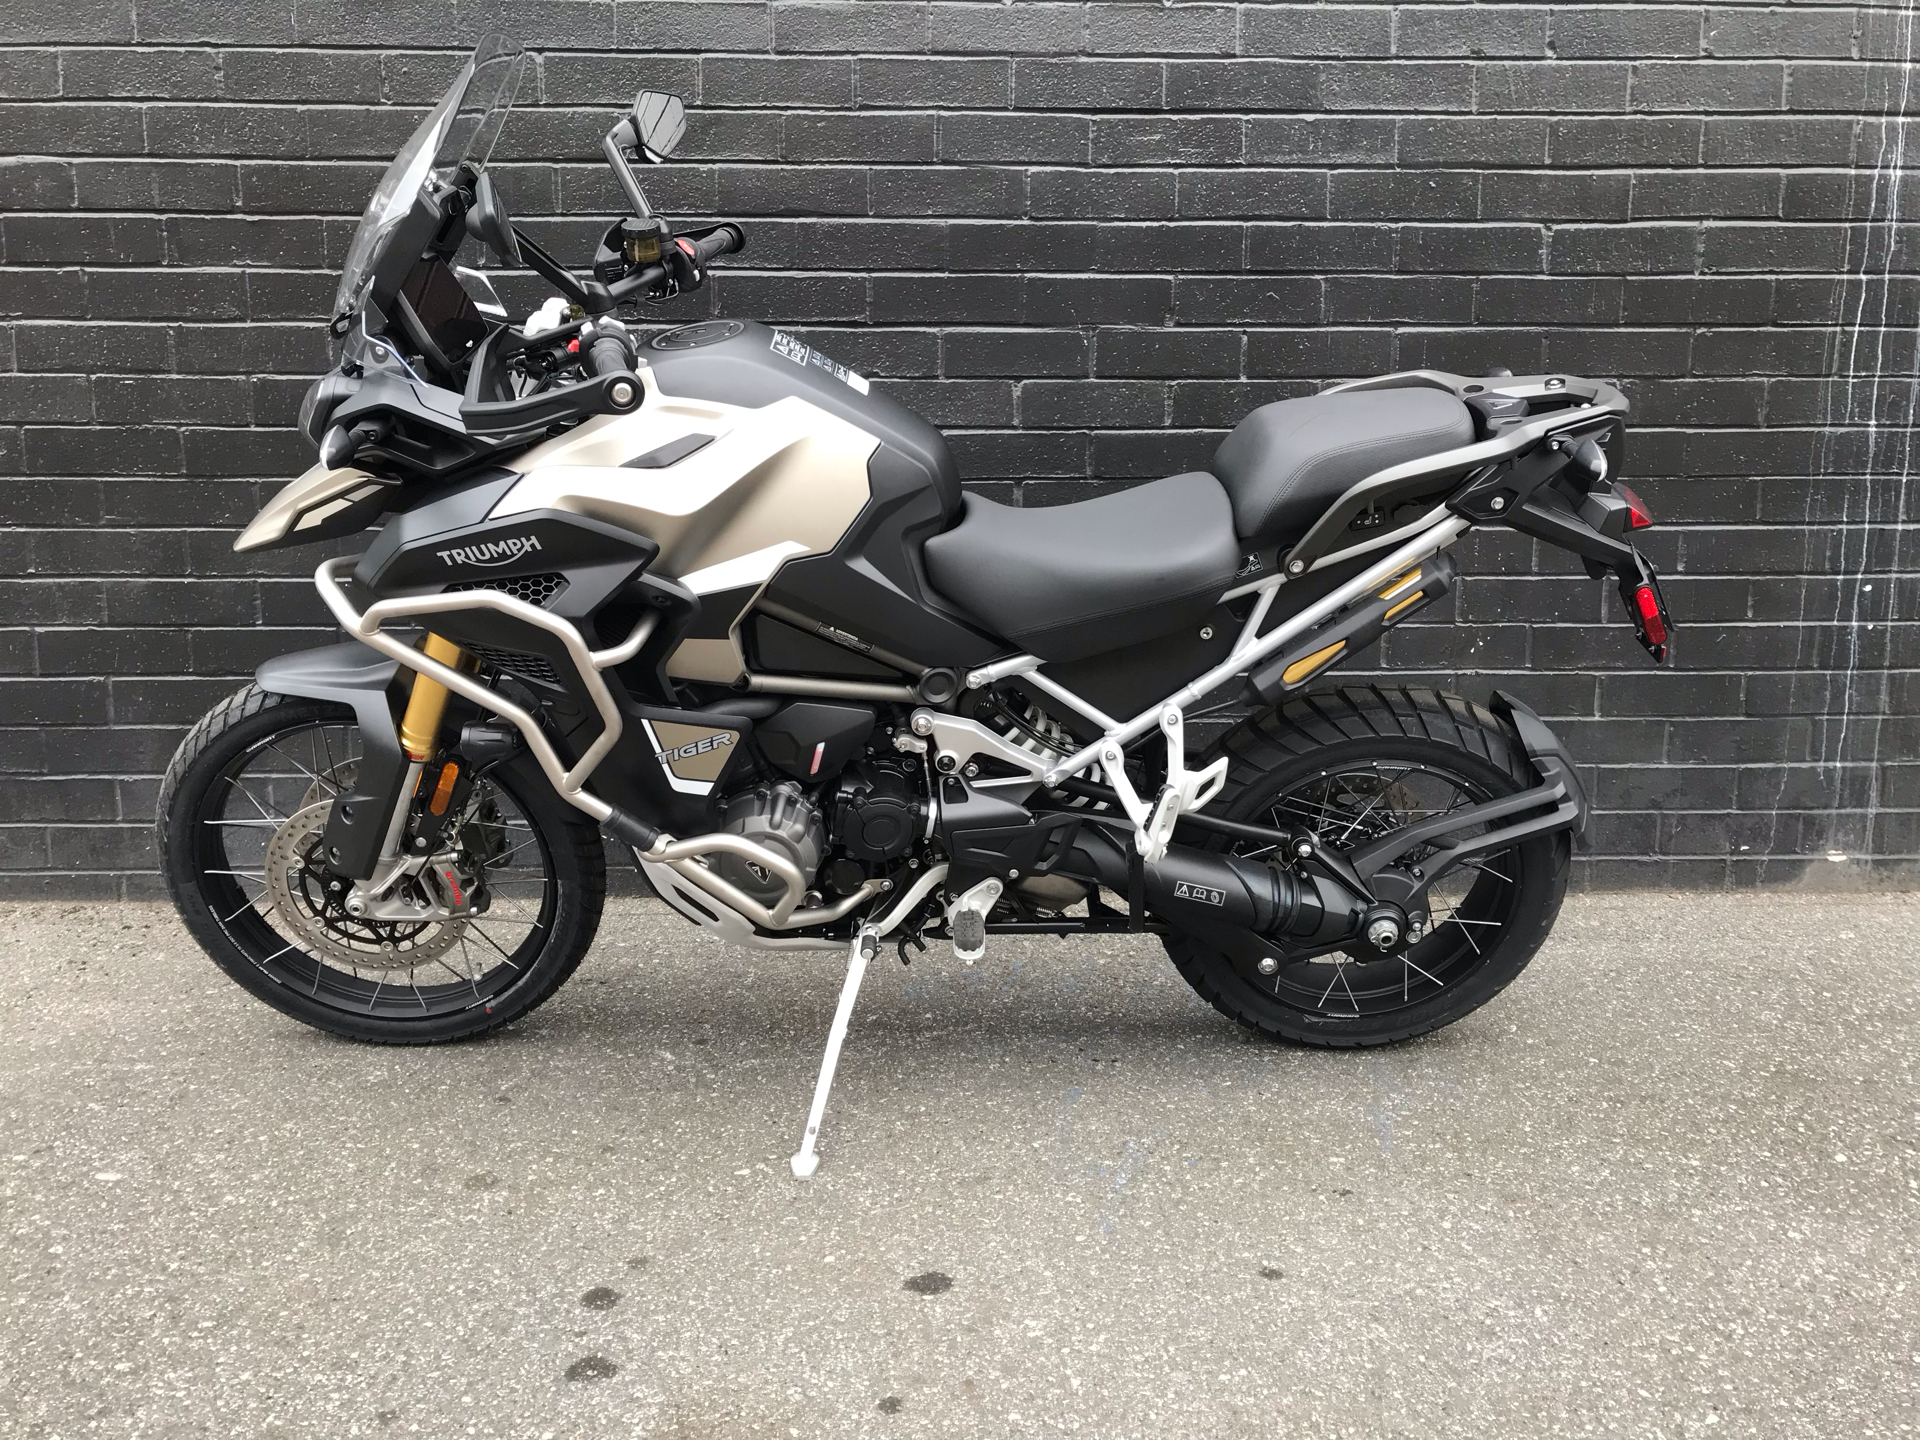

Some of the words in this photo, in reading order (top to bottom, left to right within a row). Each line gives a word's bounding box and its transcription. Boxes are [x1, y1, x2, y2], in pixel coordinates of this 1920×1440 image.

[436, 535, 542, 566] TRIUMPH
[655, 732, 733, 764] TIGER
[445, 871, 463, 905] brembo
